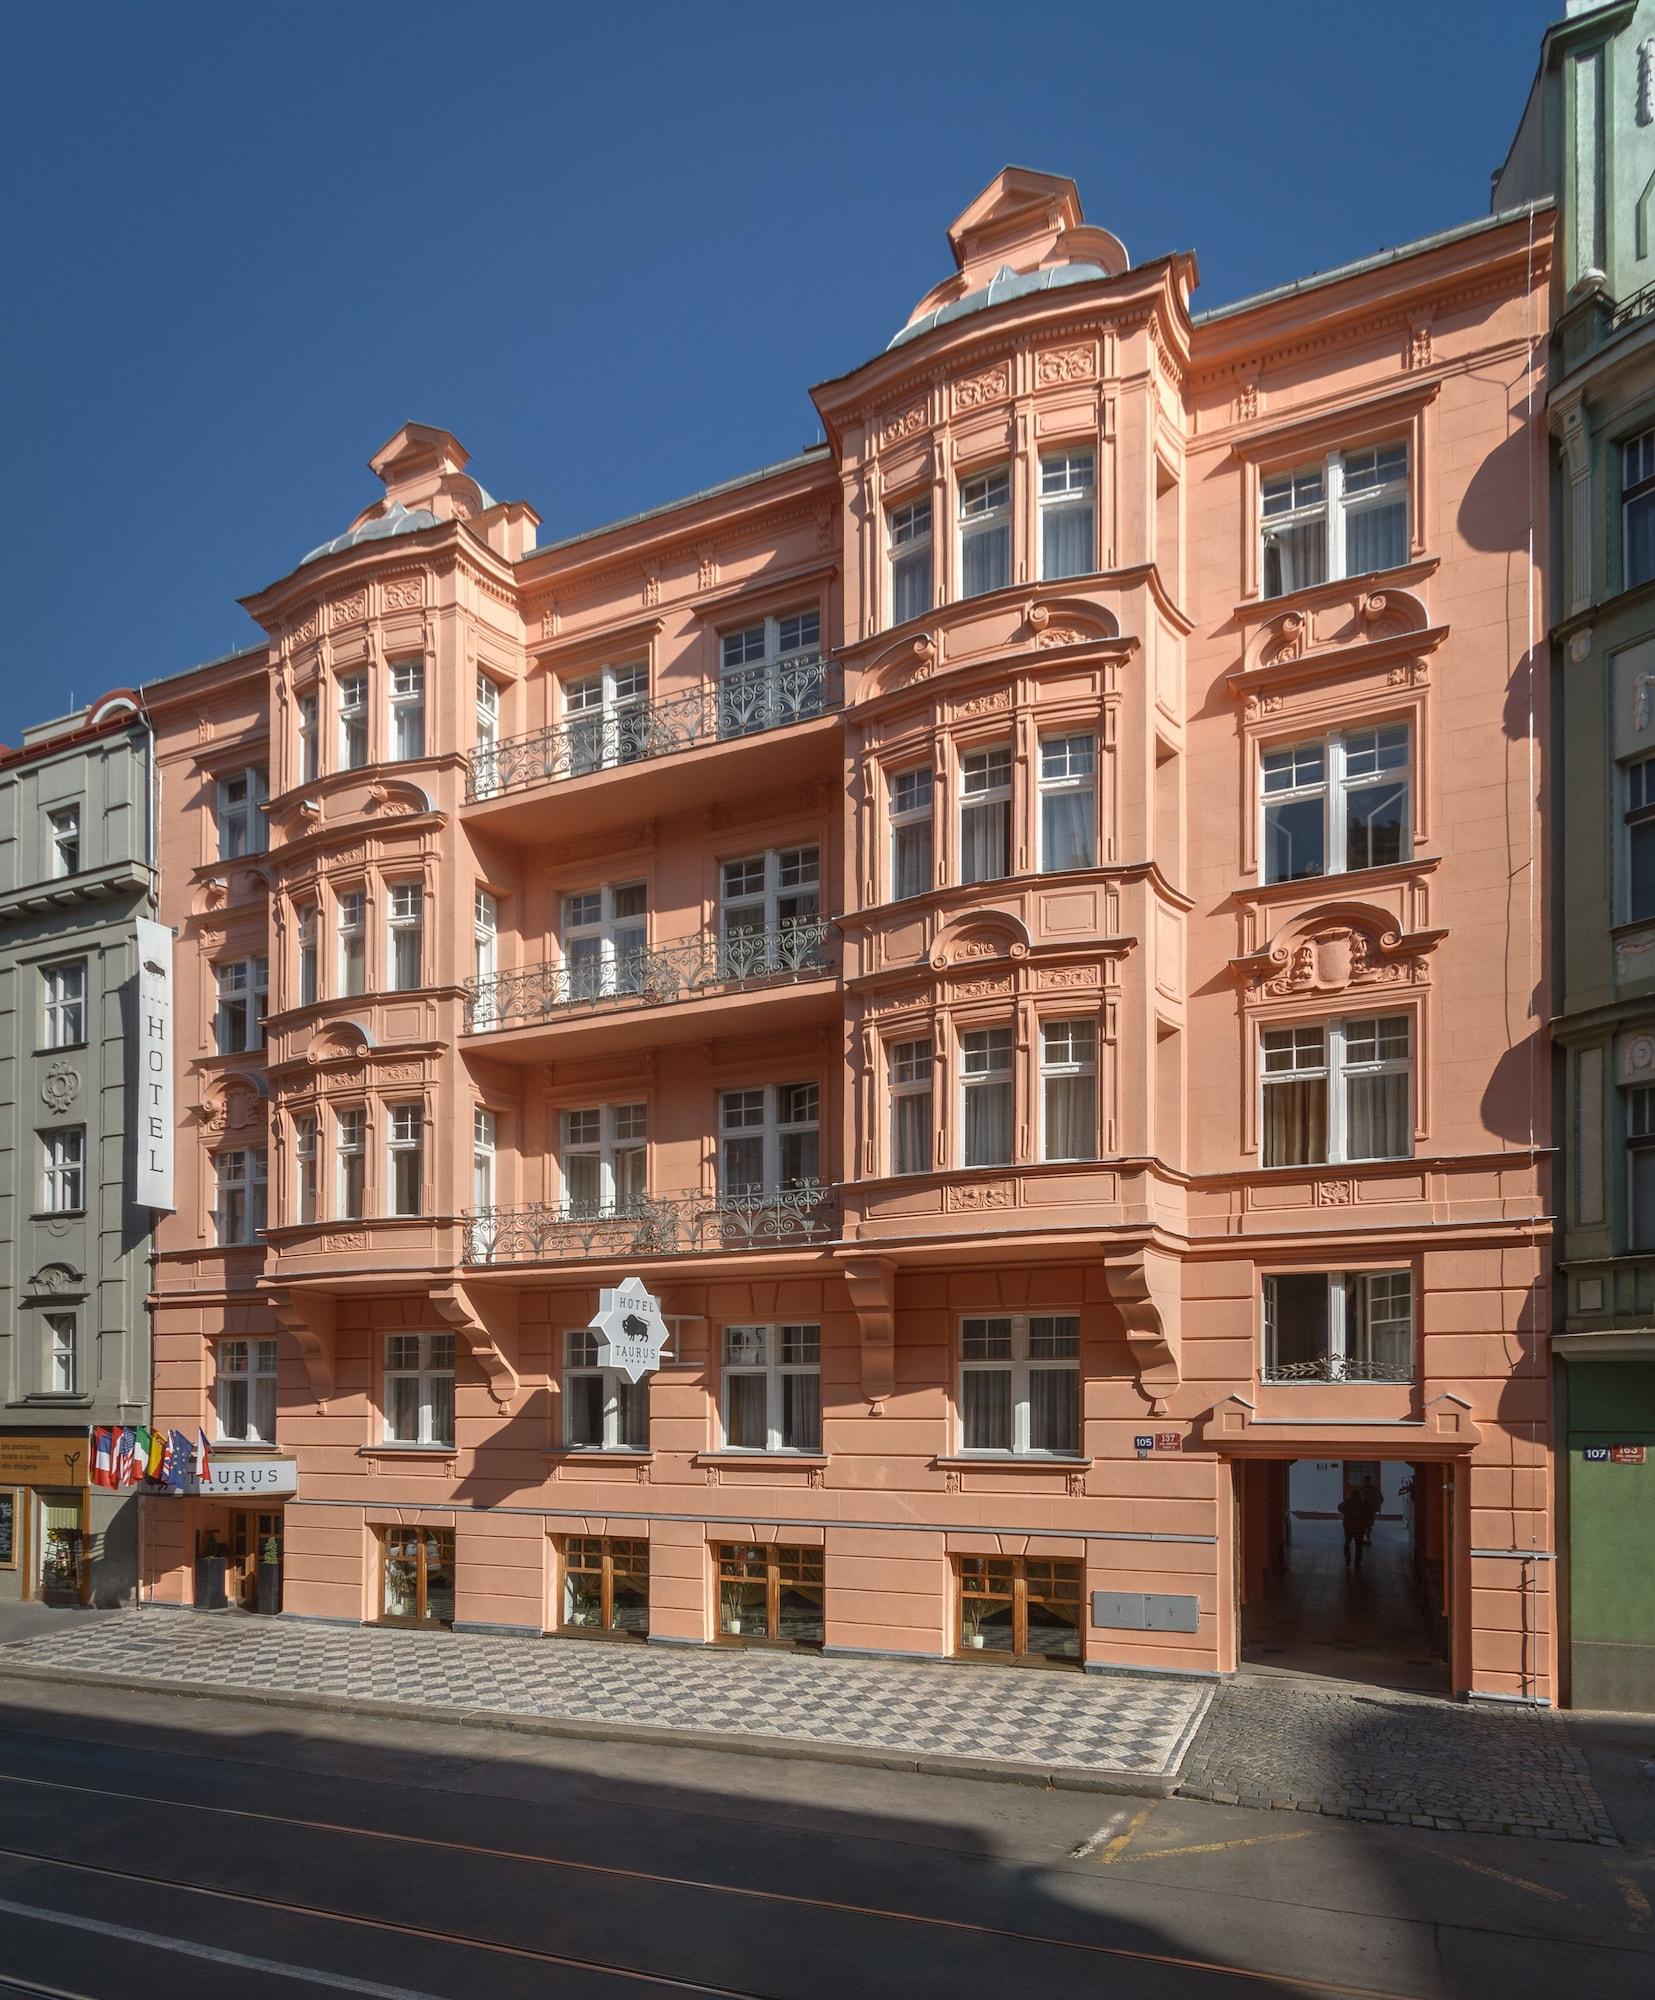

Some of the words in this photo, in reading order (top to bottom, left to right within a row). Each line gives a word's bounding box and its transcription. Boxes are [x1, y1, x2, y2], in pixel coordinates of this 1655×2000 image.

[147, 1015, 165, 1173] HOTEL
[619, 1297, 655, 1313] HOTEL
[615, 1345, 657, 1359] TAURUS
[1136, 1438, 1153, 1447] 105
[1161, 1434, 1176, 1442] 137
[1586, 1449, 1607, 1459] 107
[187, 1469, 279, 1485] TURUS
